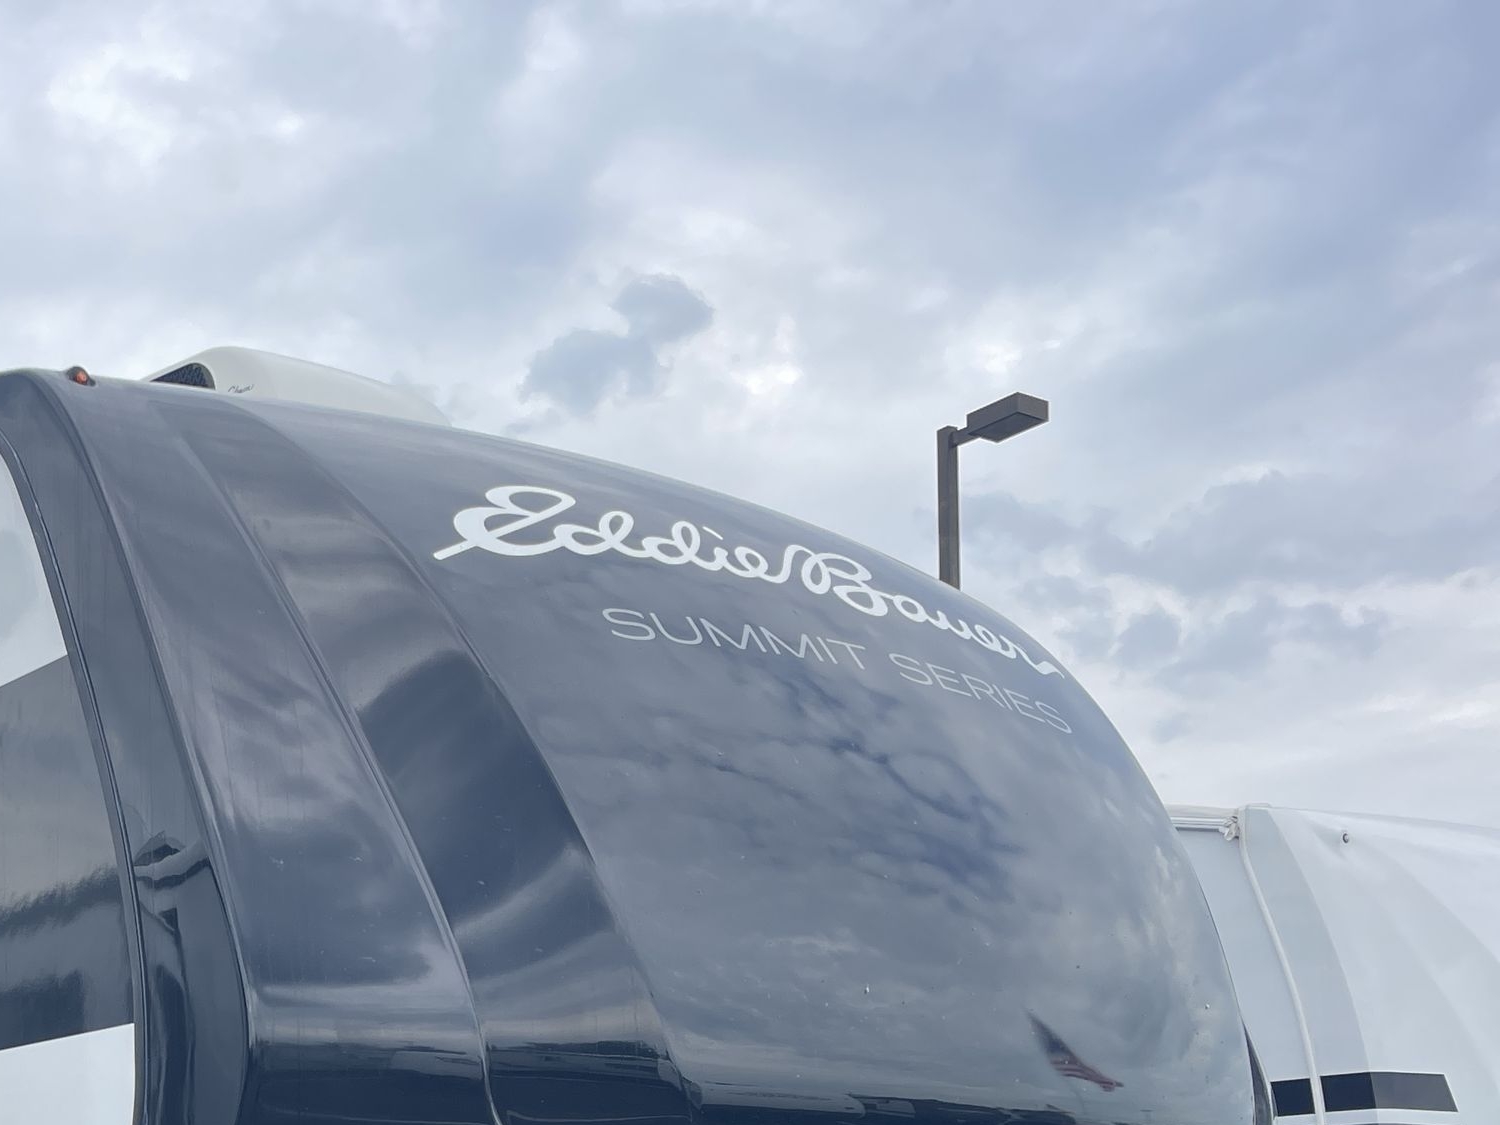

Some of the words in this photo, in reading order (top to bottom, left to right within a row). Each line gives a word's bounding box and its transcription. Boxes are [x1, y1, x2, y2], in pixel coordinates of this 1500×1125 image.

[432, 485, 776, 583] Eddie
[777, 544, 1065, 679] Bauer
[601, 607, 866, 670] SUMMIT
[888, 652, 1074, 735] SERIES
